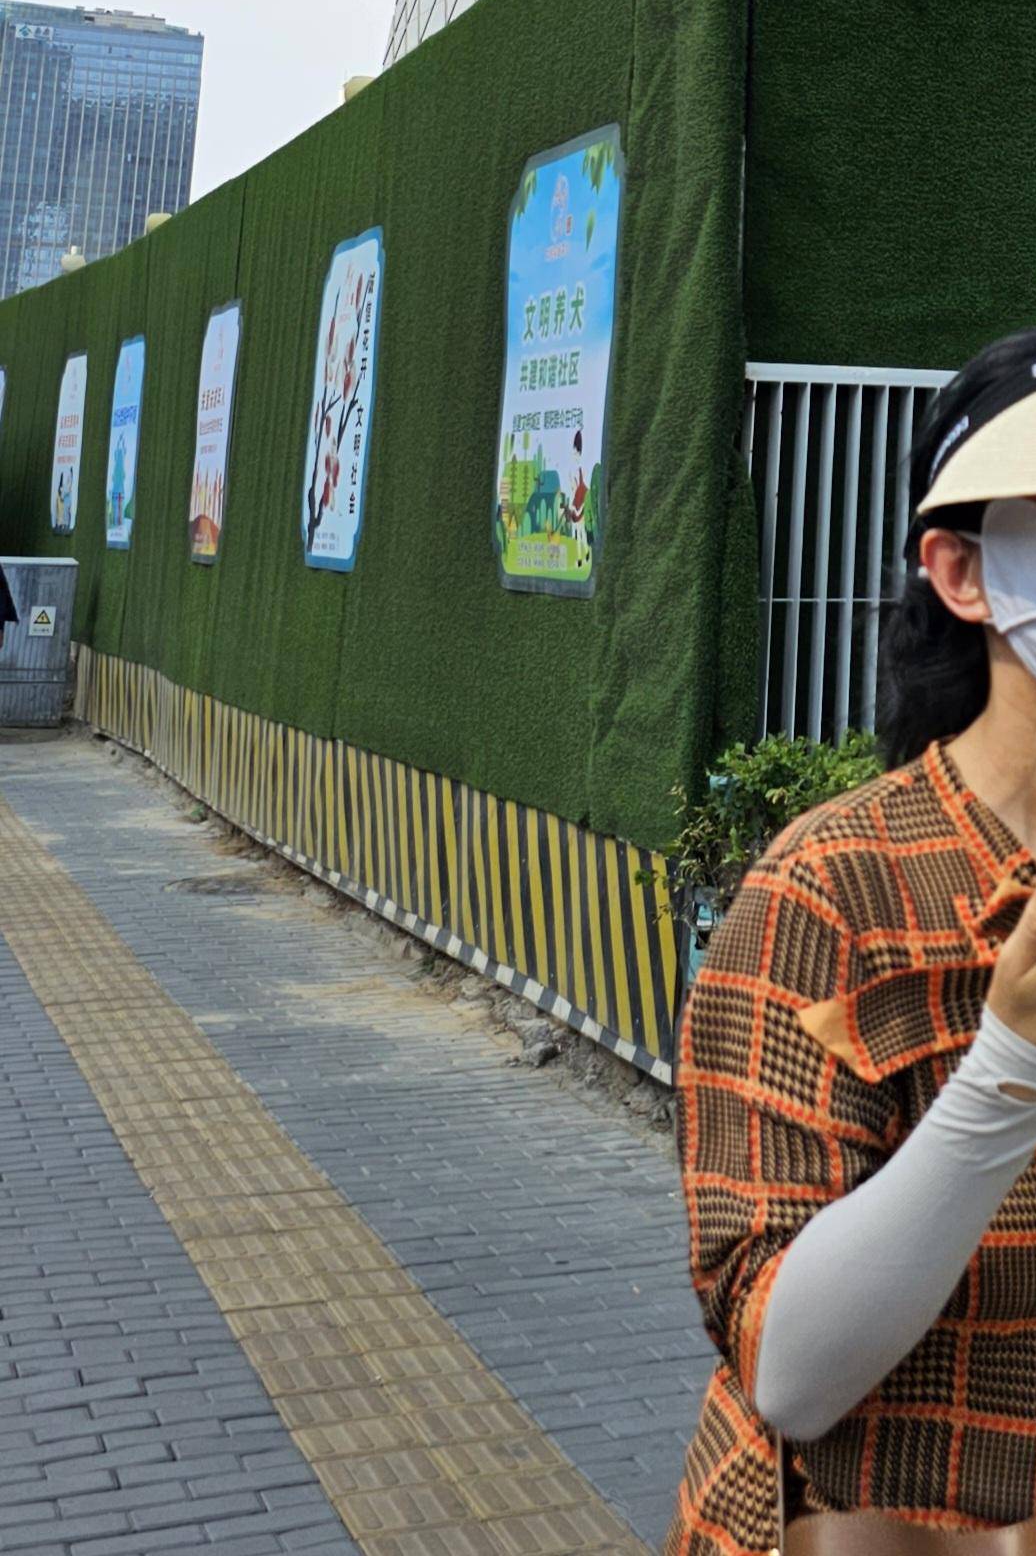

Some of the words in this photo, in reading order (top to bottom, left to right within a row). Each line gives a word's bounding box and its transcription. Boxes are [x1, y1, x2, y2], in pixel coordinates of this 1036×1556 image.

[523, 285, 585, 340] 文明养犬
[519, 351, 581, 393] 共建和谐社区
